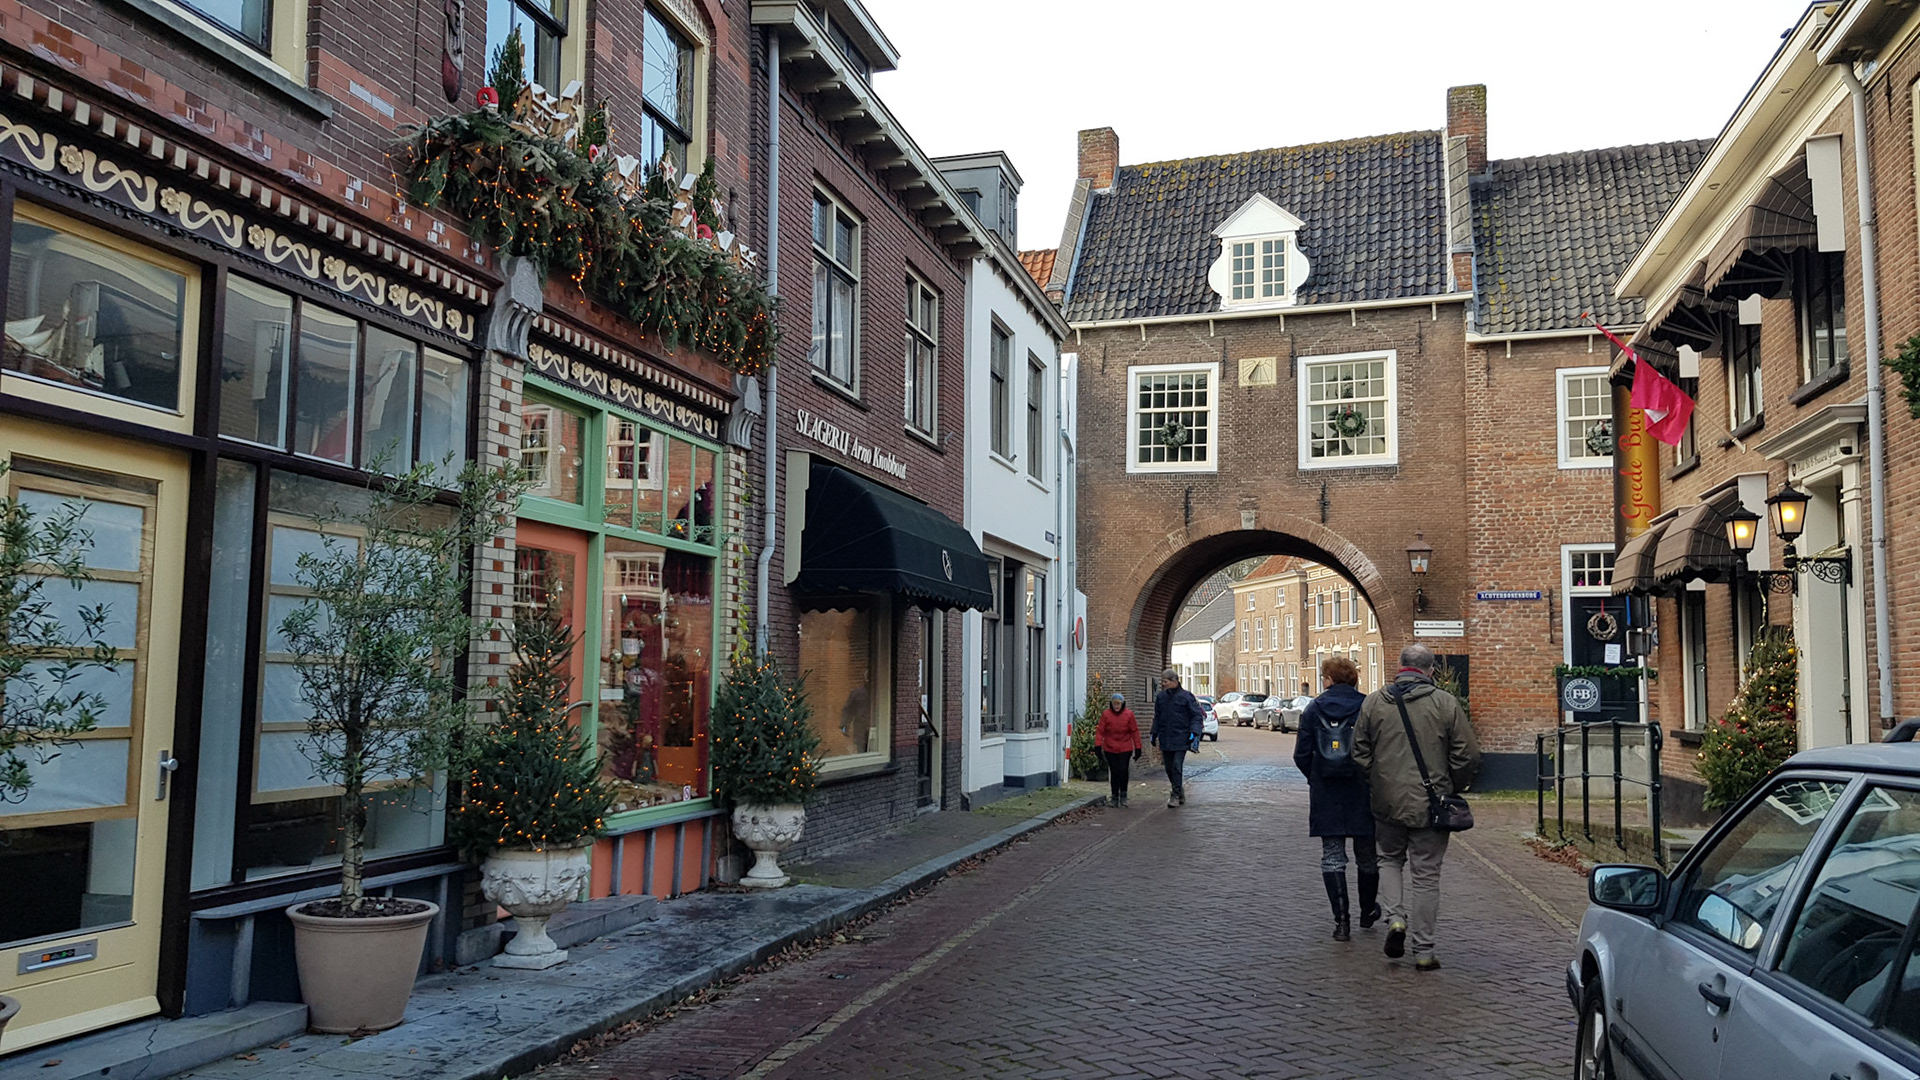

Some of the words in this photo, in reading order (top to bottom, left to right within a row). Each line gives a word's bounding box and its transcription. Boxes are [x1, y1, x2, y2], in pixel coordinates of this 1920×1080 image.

[796, 409, 850, 455] SLAGERIJ
[851, 437, 872, 463] Arno
[1618, 409, 1642, 452] Bur
[1619, 458, 1655, 519] Goede
